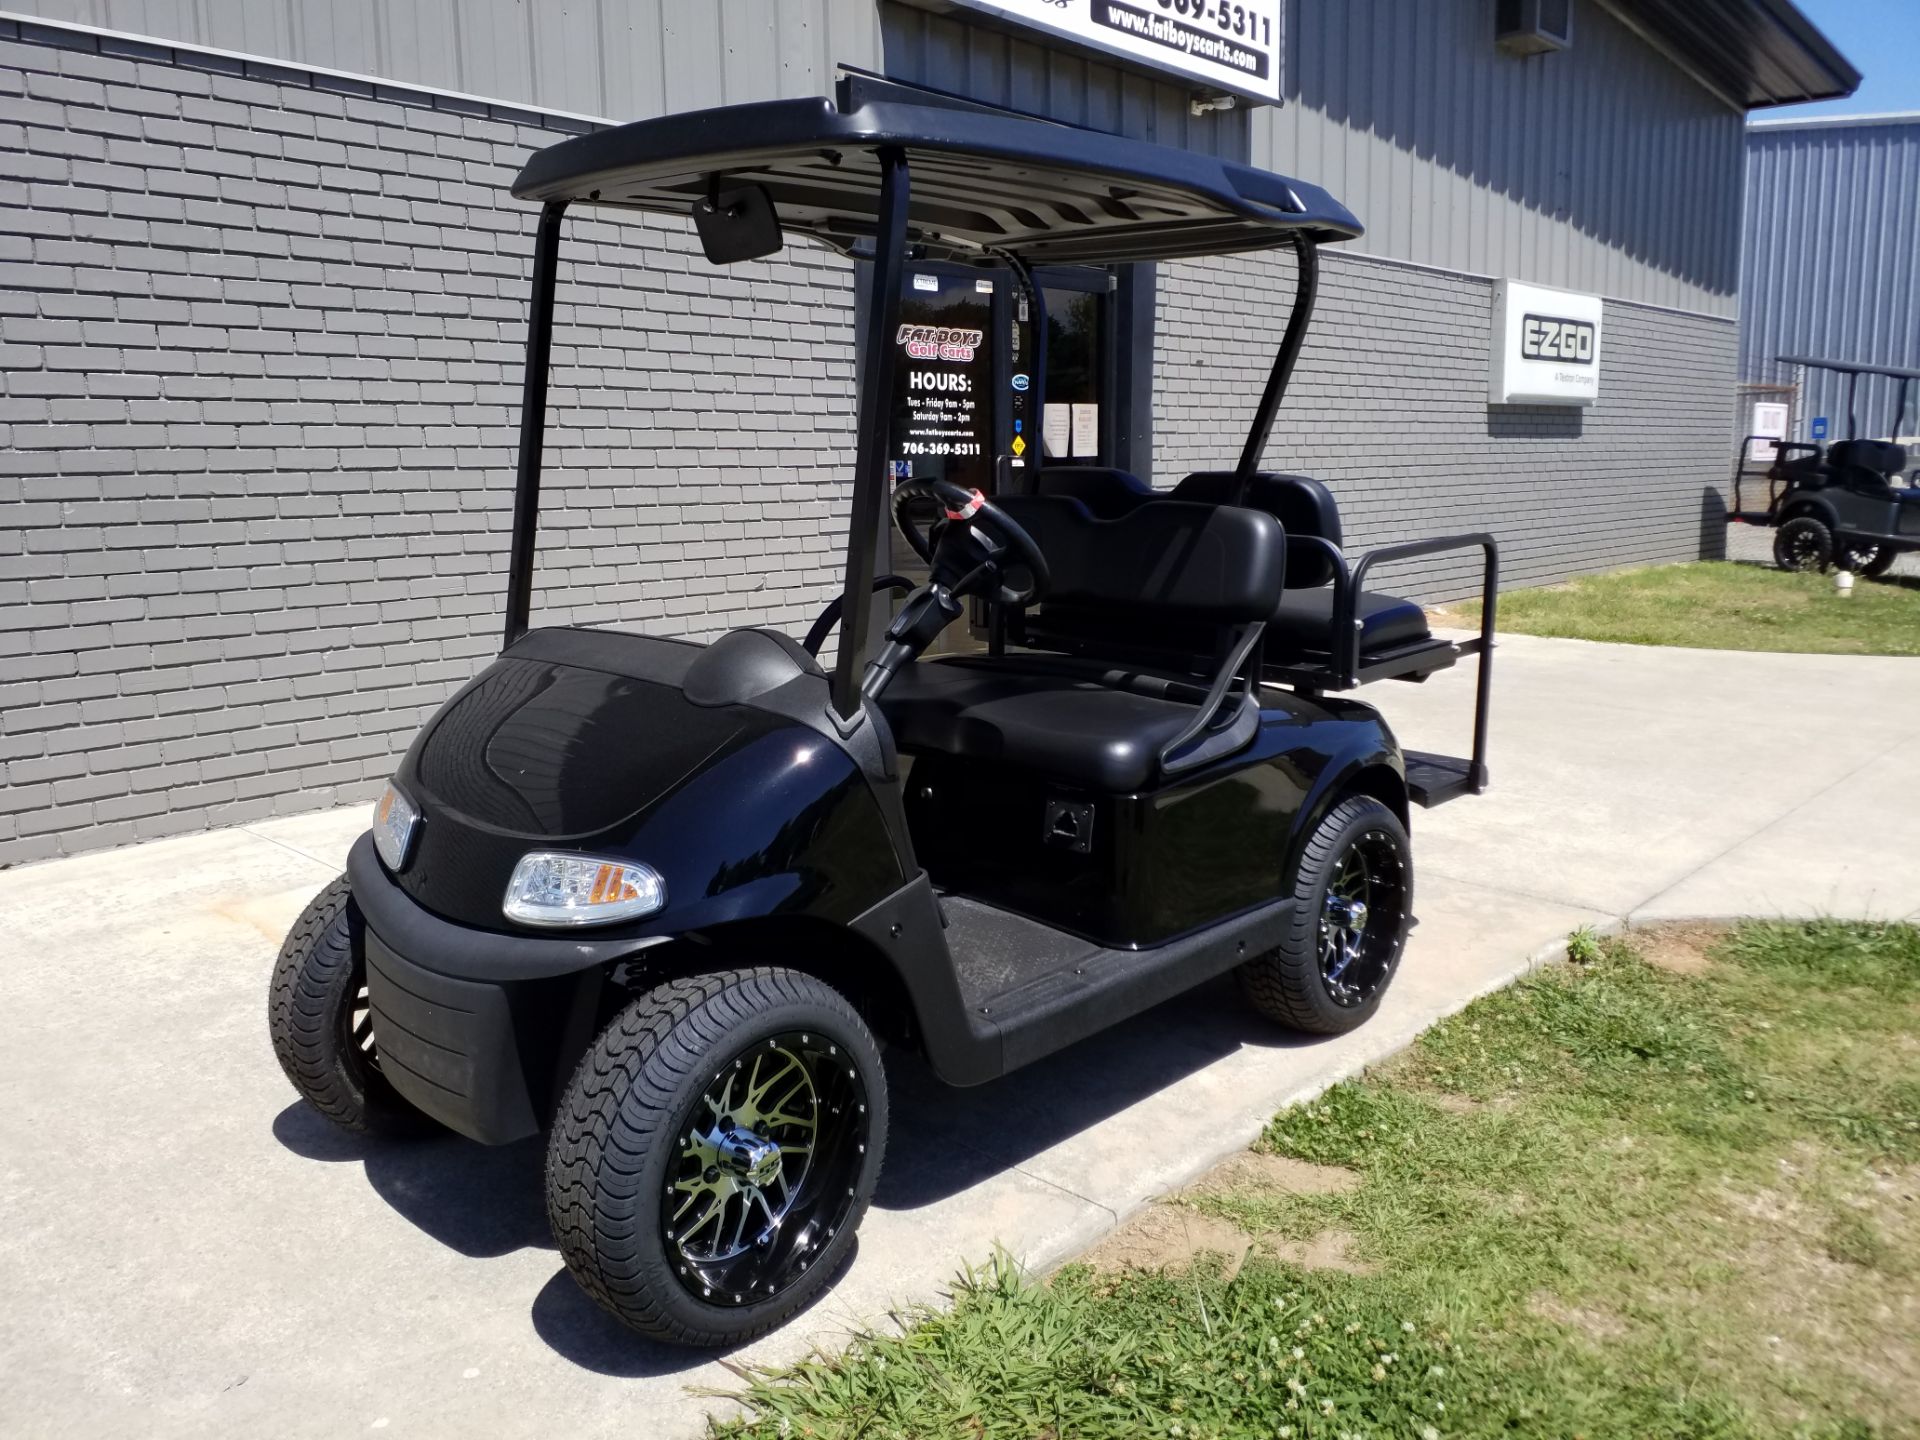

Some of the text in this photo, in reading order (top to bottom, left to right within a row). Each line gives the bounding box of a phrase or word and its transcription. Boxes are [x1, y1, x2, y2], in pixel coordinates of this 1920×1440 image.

[1157, 0, 1270, 47] 9-5311
[1107, 5, 1257, 71] www.fatboyscarts.com
[899, 326, 982, 347] FAT BOYS
[1524, 319, 1593, 361] EZGO
[908, 341, 973, 360] Golf Carts
[910, 371, 972, 392] HOURS:
[907, 396, 921, 408] Tues
[926, 397, 944, 410] Friday
[945, 398, 958, 409] 9am
[962, 399, 975, 411] 5pm
[913, 410, 939, 424] Saturday
[940, 411, 953, 421] 9am
[958, 412, 970, 424] 2pm
[909, 428, 974, 438] www.fatboyscarts.com
[903, 442, 980, 455] 706-369-5311
